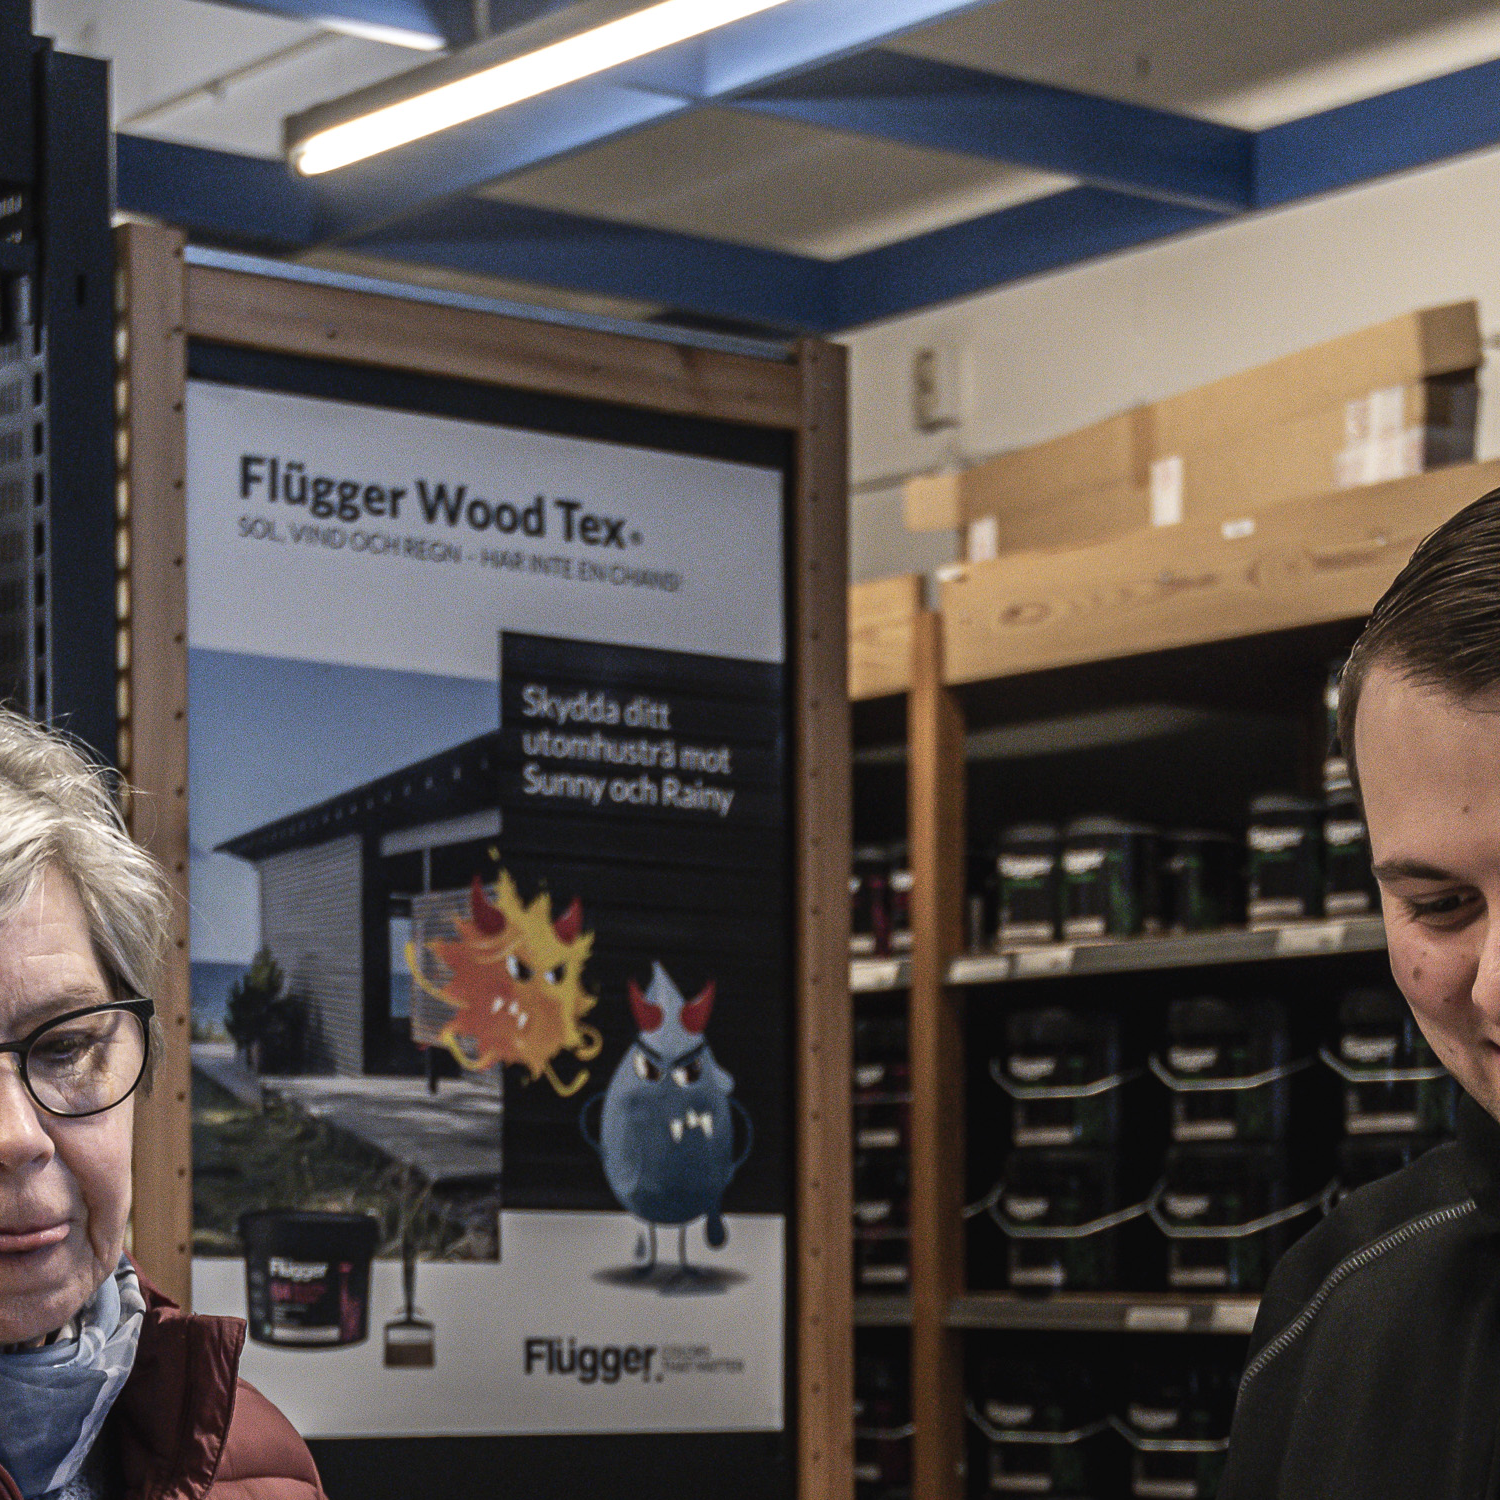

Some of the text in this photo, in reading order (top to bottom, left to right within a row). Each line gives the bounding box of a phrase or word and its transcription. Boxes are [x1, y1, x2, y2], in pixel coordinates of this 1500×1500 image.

[239, 454, 407, 523] Flügger
[414, 476, 547, 539] Wood
[289, 523, 346, 550] VIND
[349, 530, 399, 556] OCH
[402, 537, 462, 564] REGN
[530, 553, 573, 580] INTE
[522, 683, 671, 730] Skydda ditt
[522, 729, 731, 775] utomhusträ mot
[522, 761, 735, 818] Sunny och Rainy
[524, 1336, 658, 1385] Flügger
